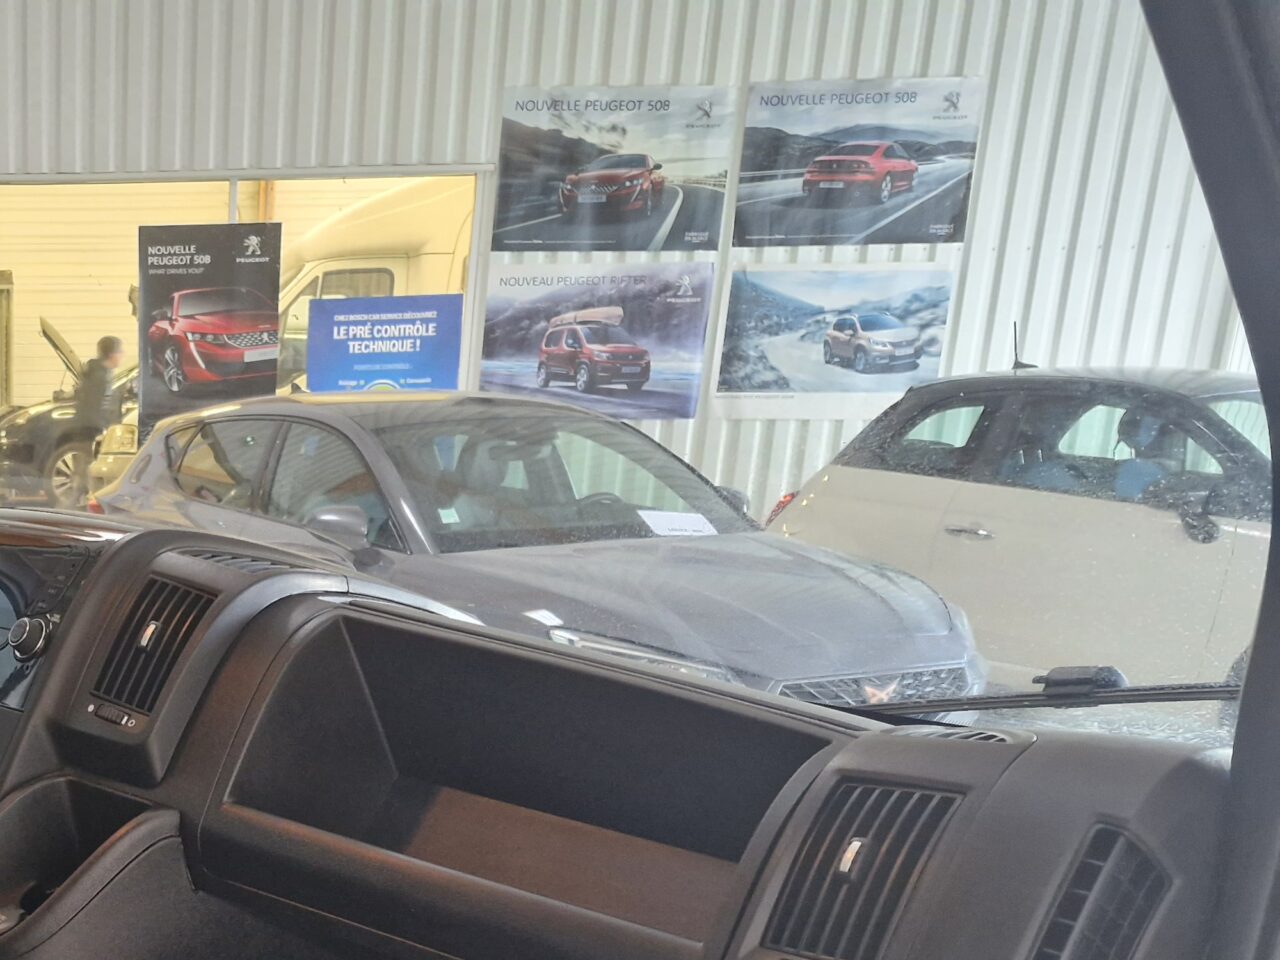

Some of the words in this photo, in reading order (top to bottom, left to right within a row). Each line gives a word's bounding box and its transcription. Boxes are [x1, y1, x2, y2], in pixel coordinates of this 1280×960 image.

[515, 100, 580, 112] NOUVELLE
[584, 99, 644, 112] PEUGEOT
[647, 99, 670, 111] 508
[759, 94, 826, 107] NOUVELLE
[830, 92, 890, 106] PEUGEOT
[894, 91, 917, 104] 508
[147, 245, 197, 255] NOUVELLE
[147, 255, 192, 266] PEUGEOT
[499, 276, 553, 287] NOUVEAU
[556, 275, 606, 286] PEUGEOT
[609, 275, 647, 286] RIFTER
[333, 326, 348, 339] LE
[348, 322, 372, 339] PRÉ
[373, 320, 437, 338] CONTRÔLE
[347, 339, 414, 354] TECHNIQUE
